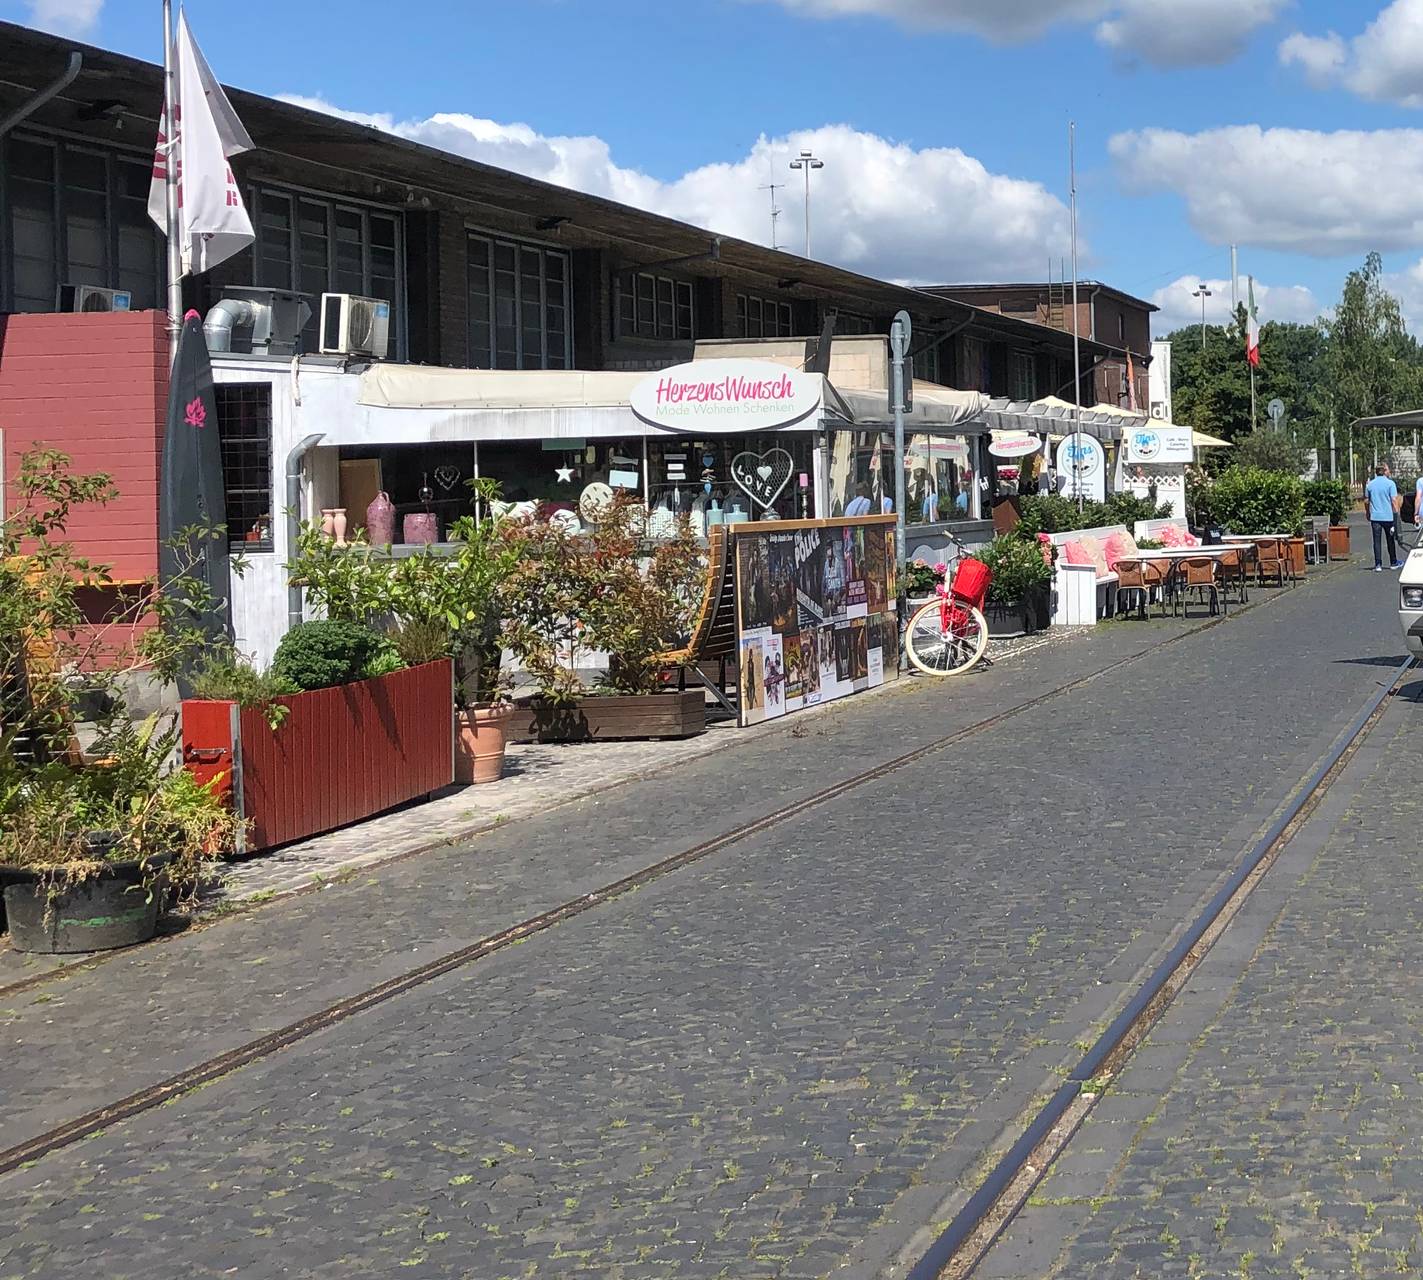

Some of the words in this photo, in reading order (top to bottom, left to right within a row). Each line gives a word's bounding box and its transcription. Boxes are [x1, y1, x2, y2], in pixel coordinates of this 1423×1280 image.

[656, 373, 795, 404] HerzensWunsch
[656, 405, 690, 416] Mode
[693, 403, 739, 415] Wohnen
[744, 401, 795, 414] Schenken
[736, 465, 773, 497] LOVE
[794, 528, 820, 569] POLICE
